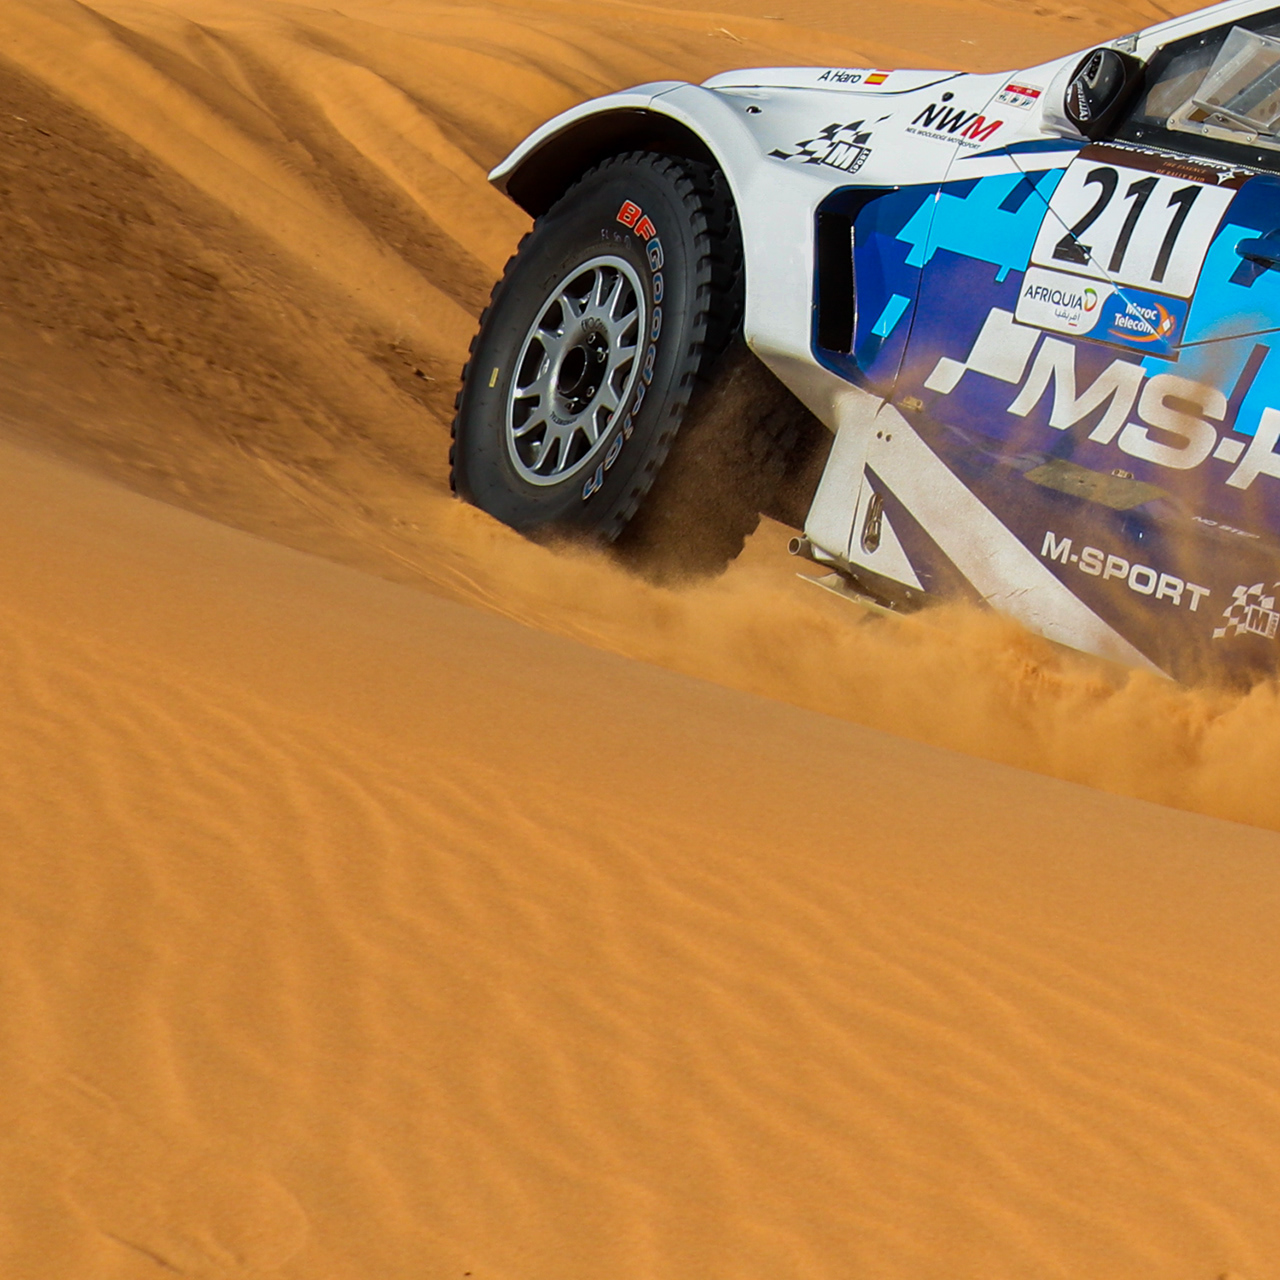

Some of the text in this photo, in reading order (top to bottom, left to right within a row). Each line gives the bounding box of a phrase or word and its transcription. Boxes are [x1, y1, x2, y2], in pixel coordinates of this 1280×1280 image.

[817, 70, 862, 84] A Haro
[911, 103, 1004, 142] NWM
[1165, 170, 1187, 179] RALLY
[1176, 163, 1207, 173] ESSENCE
[1051, 166, 1204, 283] 211
[1023, 284, 1083, 311] AFRIQUIA
[1125, 302, 1158, 320] Maroc
[1114, 312, 1156, 334] Telecom
[1040, 531, 1211, 612] M-SPORT
